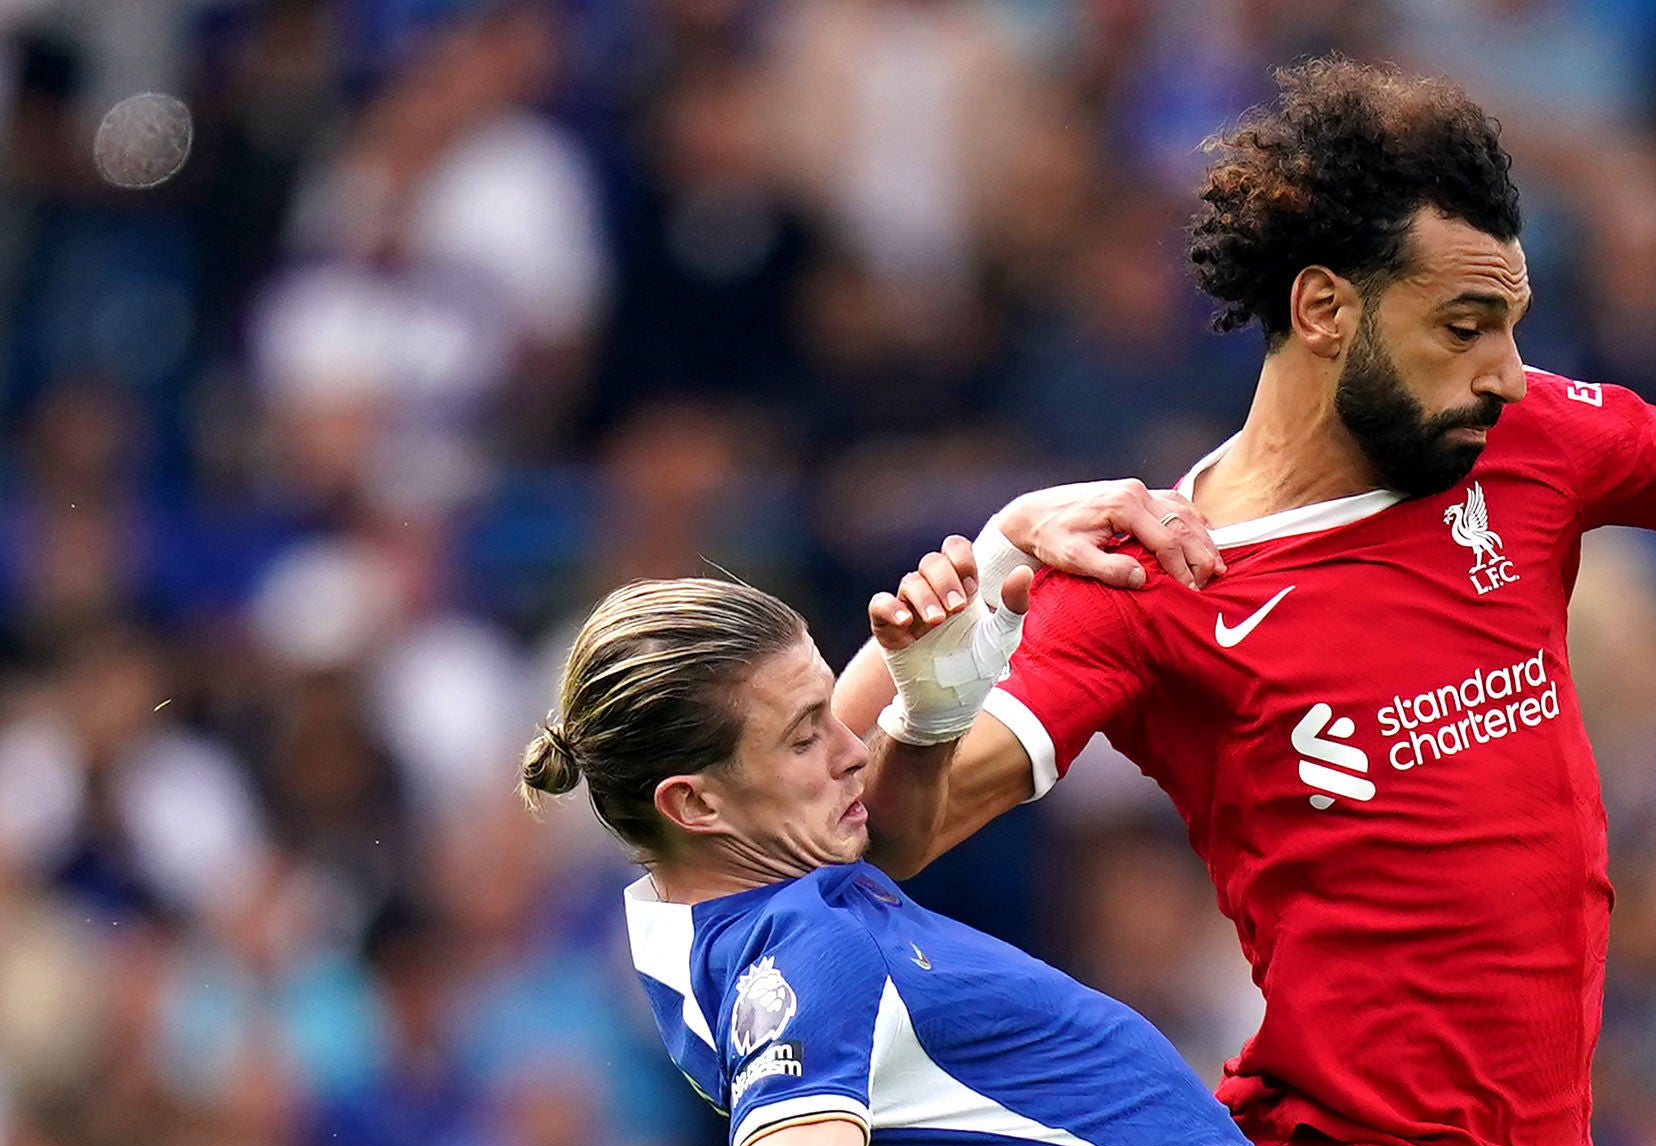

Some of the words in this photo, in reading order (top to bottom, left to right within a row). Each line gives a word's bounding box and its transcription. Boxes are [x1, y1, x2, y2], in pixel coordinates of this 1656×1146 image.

[1470, 561, 1520, 594] L.F.C.
[1377, 648, 1547, 736] standard
[1389, 681, 1560, 770] chartered
